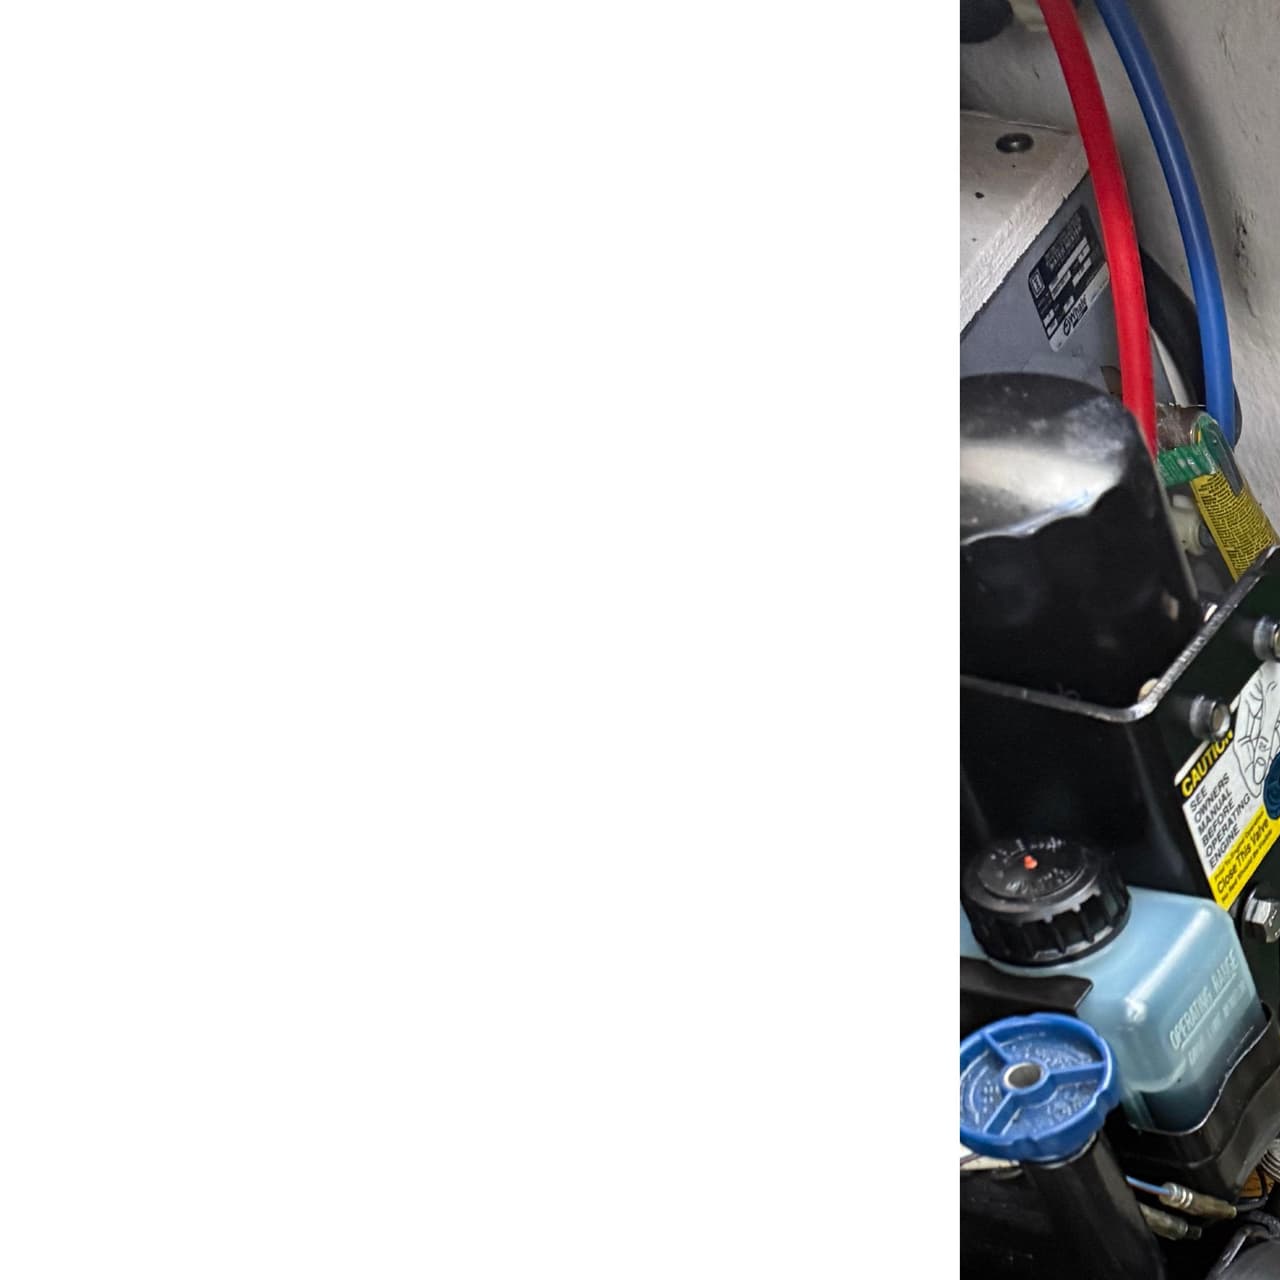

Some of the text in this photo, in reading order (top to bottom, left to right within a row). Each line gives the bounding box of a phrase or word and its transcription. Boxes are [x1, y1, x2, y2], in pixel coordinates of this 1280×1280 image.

[1190, 785, 1207, 812] SEE
[1194, 773, 1230, 824] OWNERS
[1199, 787, 1232, 834] MANUAL
[1202, 800, 1234, 847] BEFORE
[1206, 793, 1250, 857] OPERATING
[1209, 824, 1240, 869] ENGINE
[1217, 819, 1269, 894] Close This Valve
